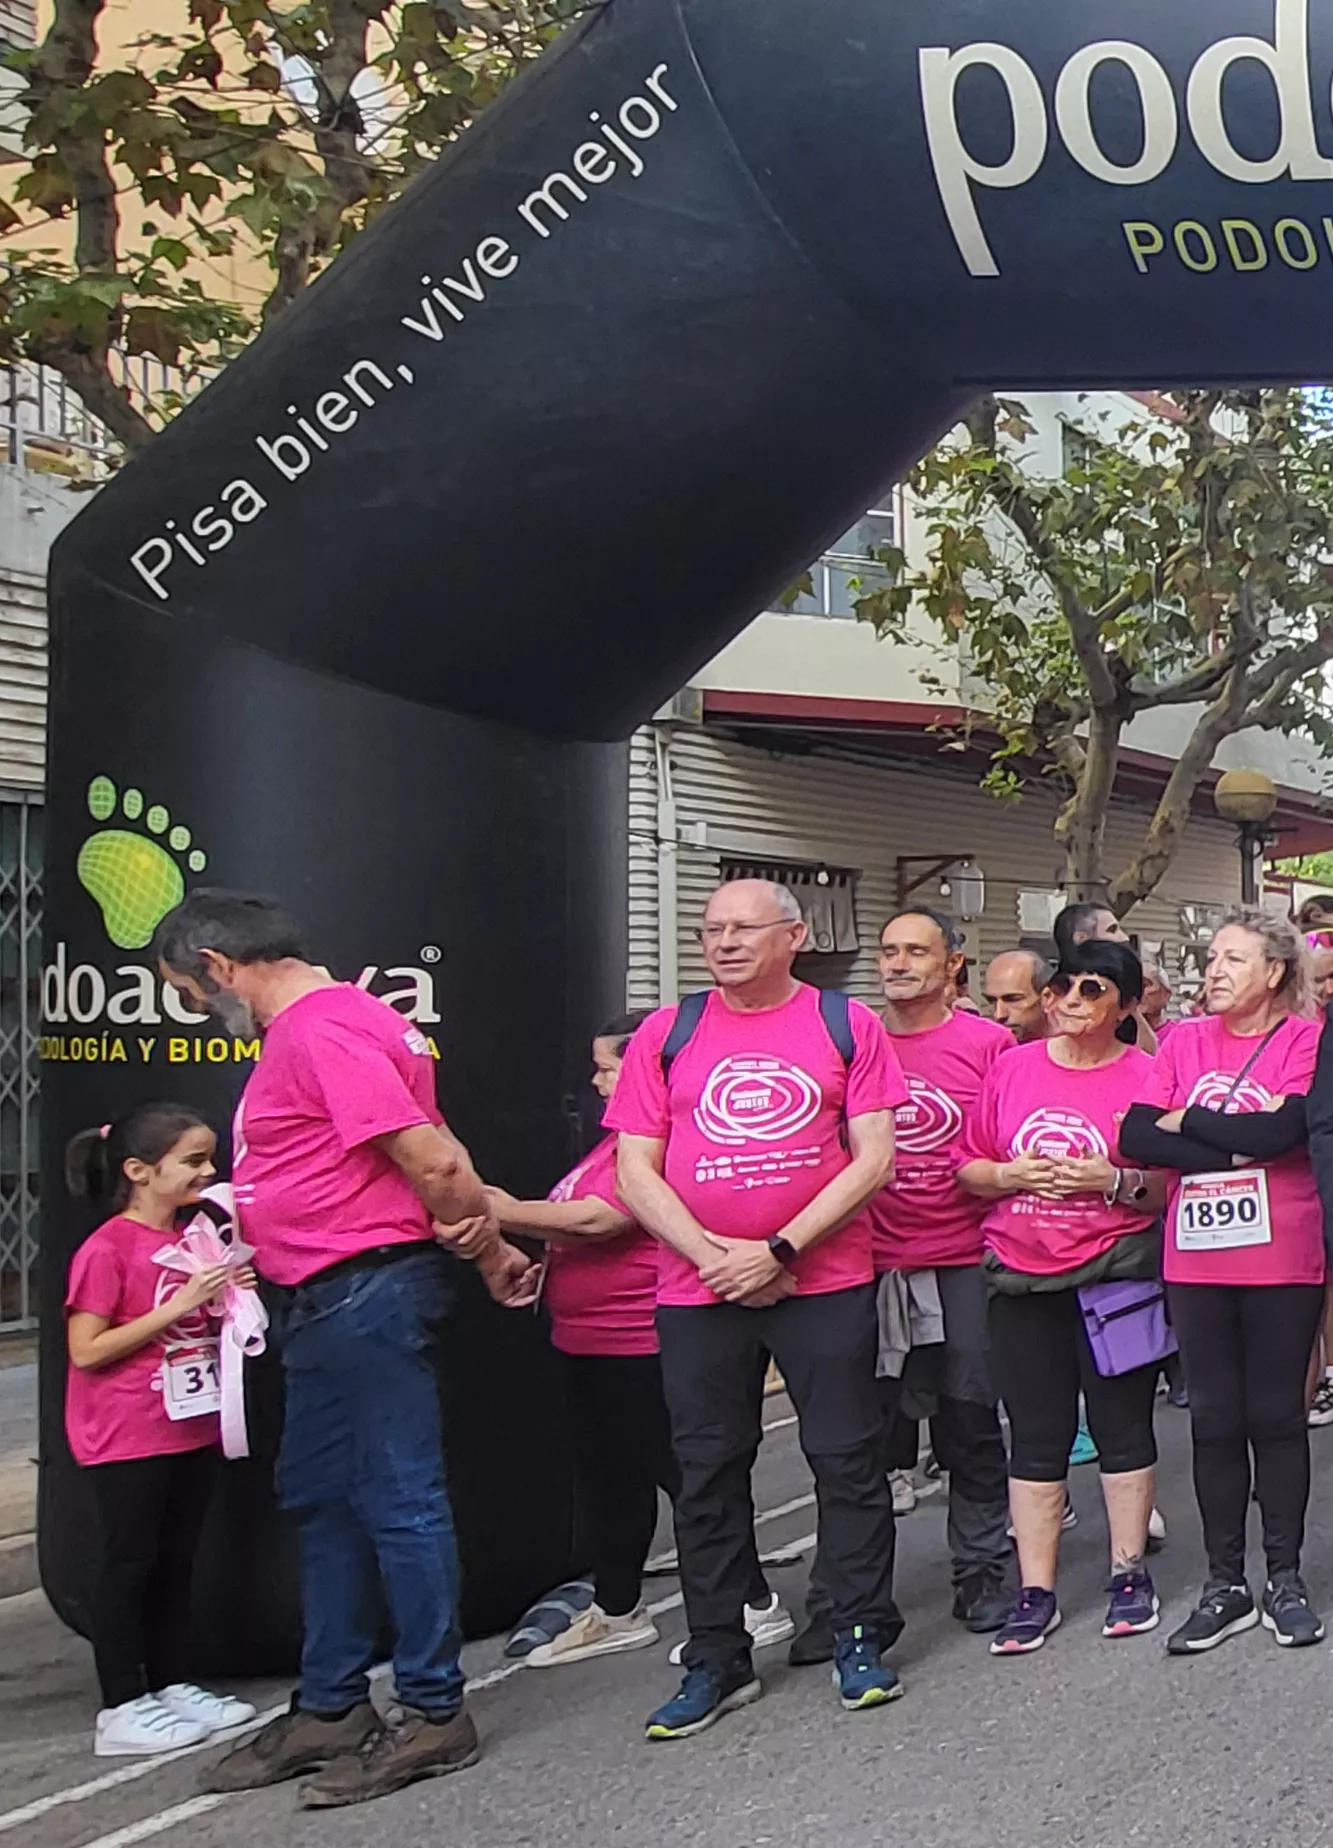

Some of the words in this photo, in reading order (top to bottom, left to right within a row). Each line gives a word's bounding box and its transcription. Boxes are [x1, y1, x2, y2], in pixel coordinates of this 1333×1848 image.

[130, 478, 268, 601] Pisa
[256, 358, 416, 483] bien,
[400, 236, 520, 344] vive
[515, 61, 679, 240] mejor
[136, 1036, 158, 1064] Y
[1184, 1197, 1257, 1229] 1890
